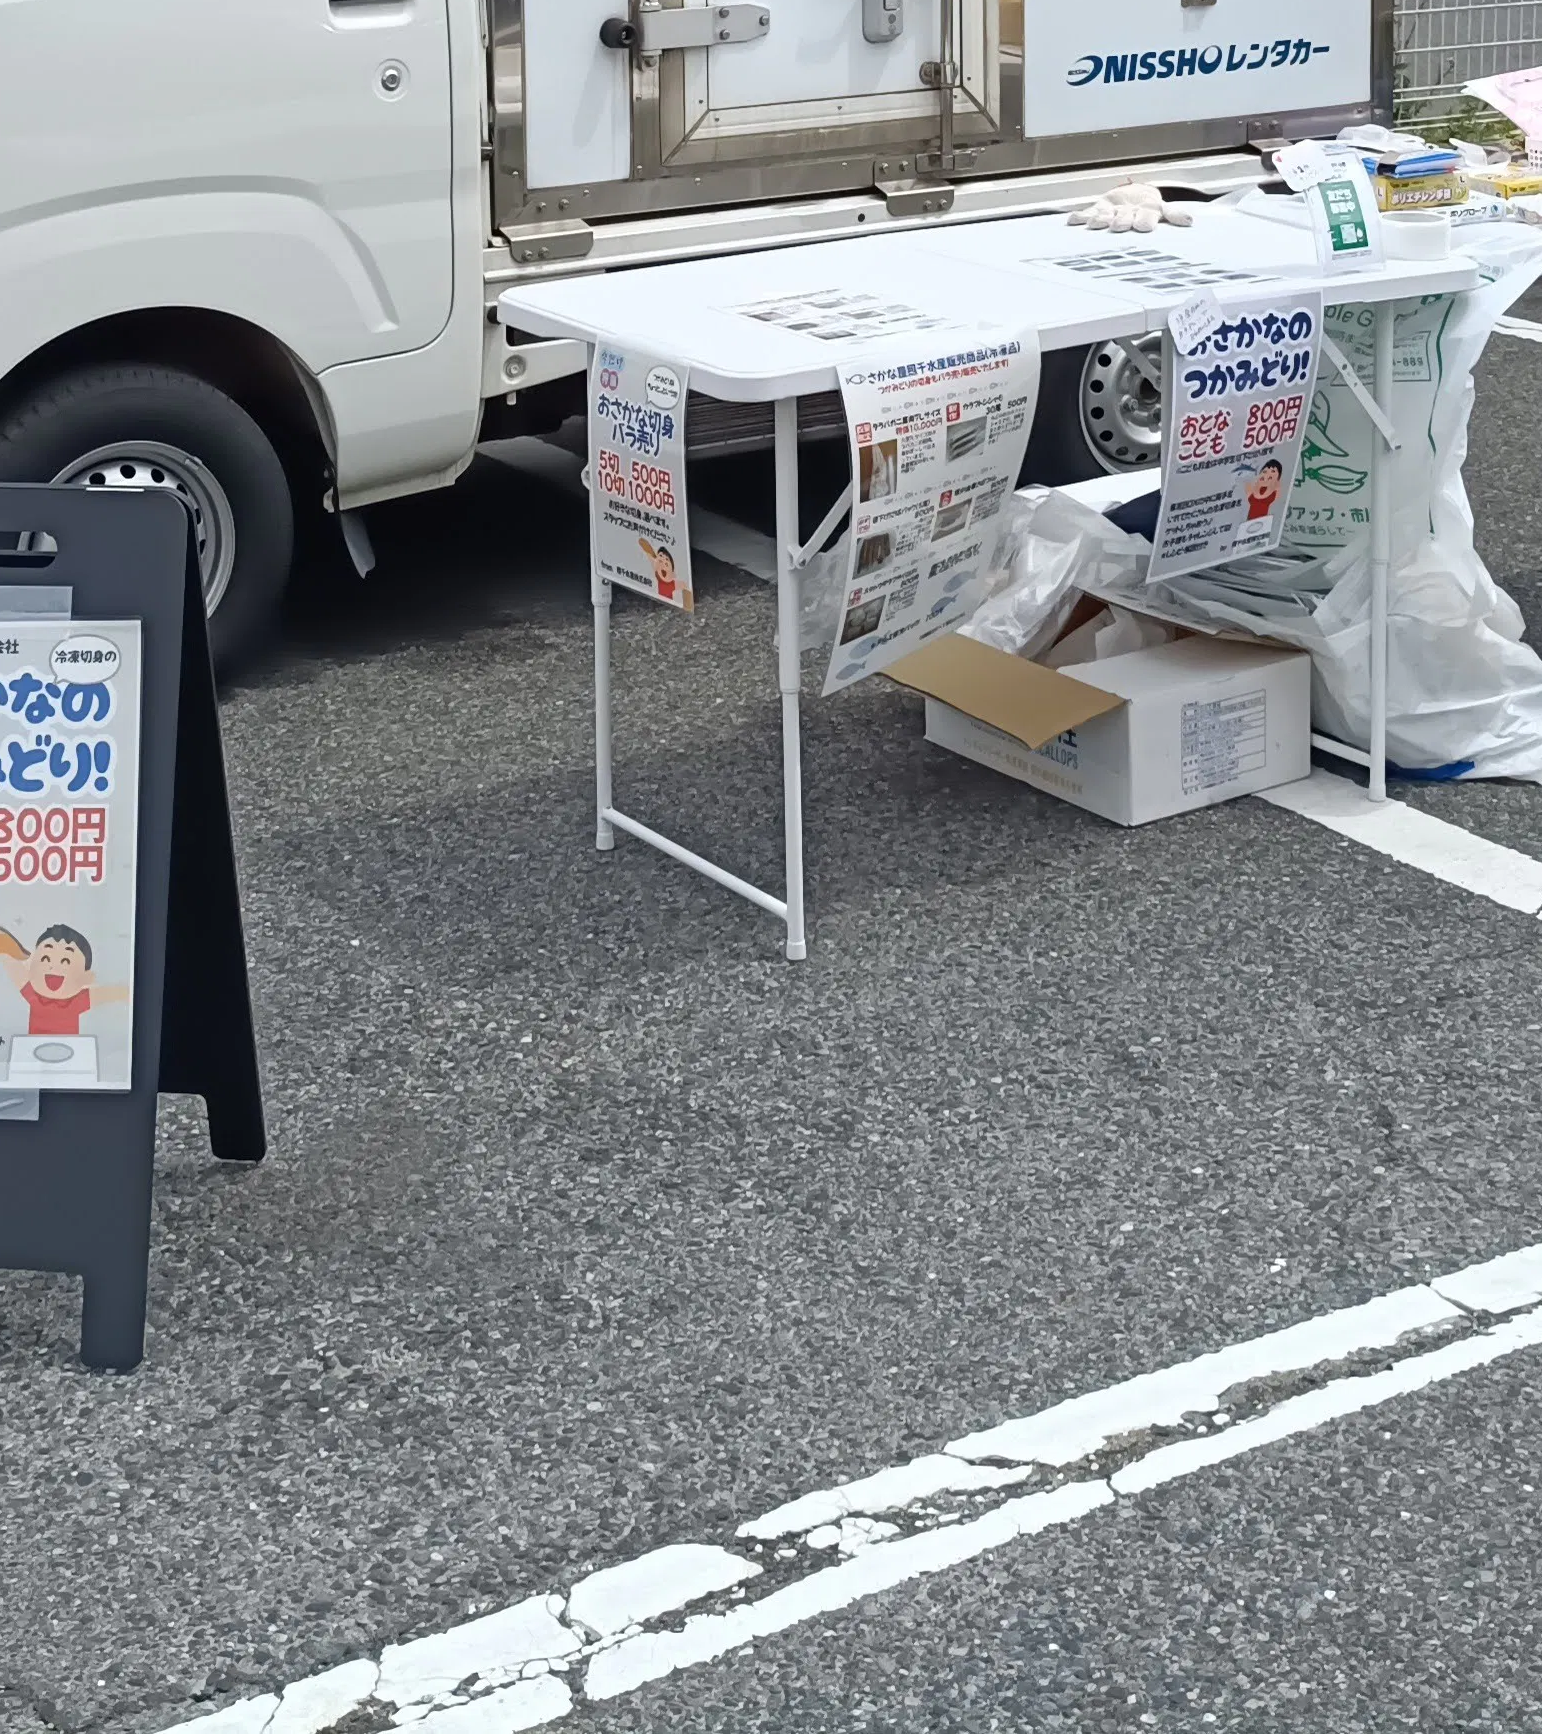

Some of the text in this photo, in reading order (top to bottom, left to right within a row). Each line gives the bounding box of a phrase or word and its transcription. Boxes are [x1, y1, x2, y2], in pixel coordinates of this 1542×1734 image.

[1184, 350, 1311, 399] つかみどり!
[597, 392, 675, 439] おさかな切身
[1180, 395, 1303, 439] おとな 800円
[612, 421, 662, 457] バラ売り
[1178, 418, 1298, 461] こども 500円
[597, 470, 675, 515] 10切 1000円
[599, 450, 671, 493] 5切 500円
[54, 650, 117, 664] 冷凍切身の
